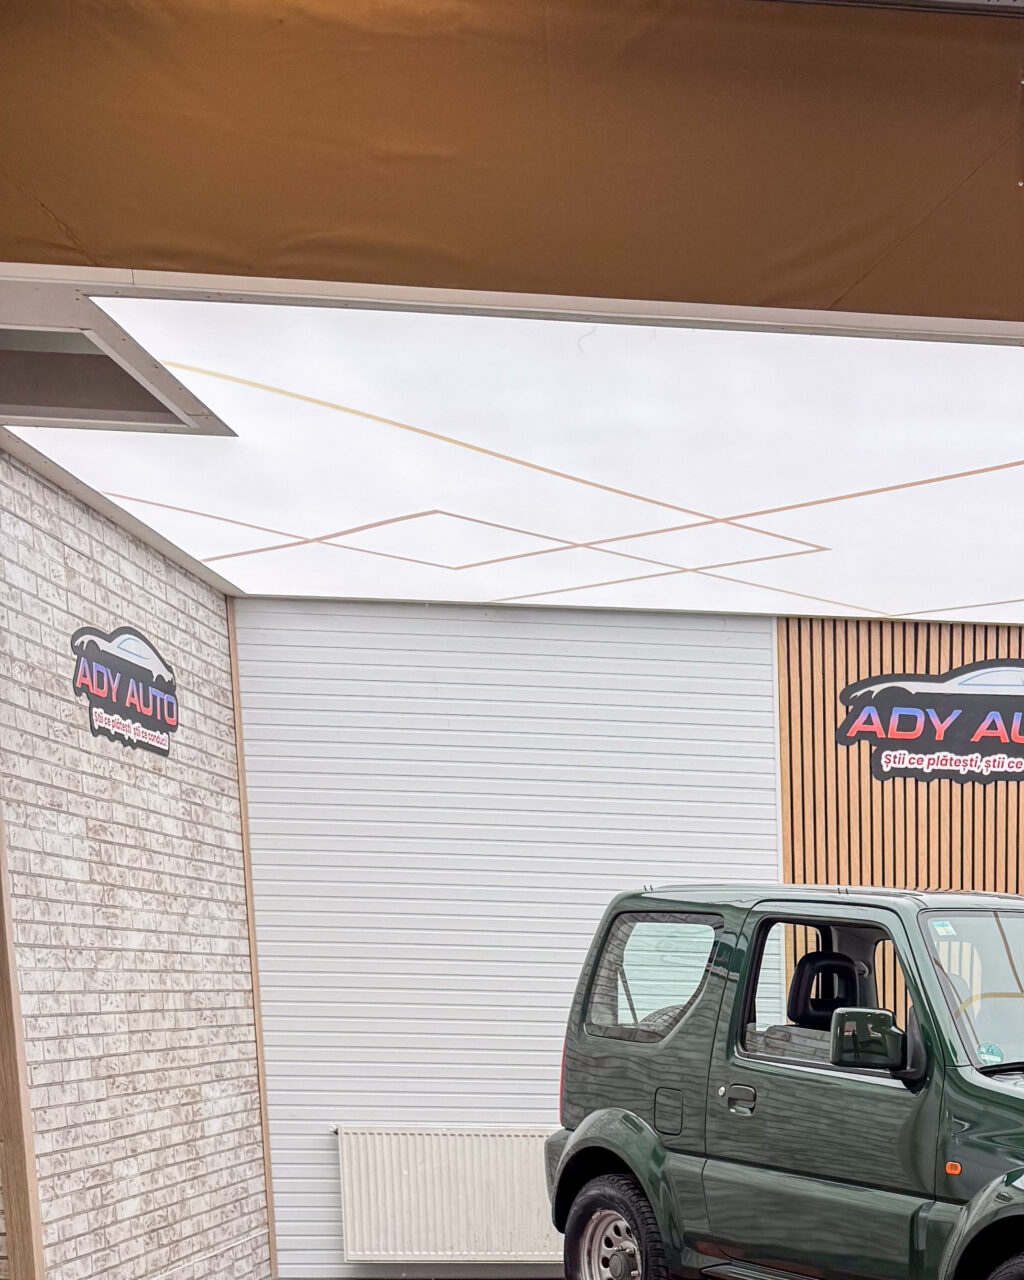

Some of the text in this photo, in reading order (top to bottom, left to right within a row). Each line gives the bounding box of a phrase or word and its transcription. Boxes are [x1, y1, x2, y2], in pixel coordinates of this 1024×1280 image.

[76, 657, 177, 726] ADY AUTO
[846, 705, 963, 741] ADY
[884, 753, 906, 768] Știi
[908, 756, 924, 766] ce
[926, 754, 981, 771] plătești,
[984, 757, 1006, 772] știi
[1007, 760, 1023, 769] ce
